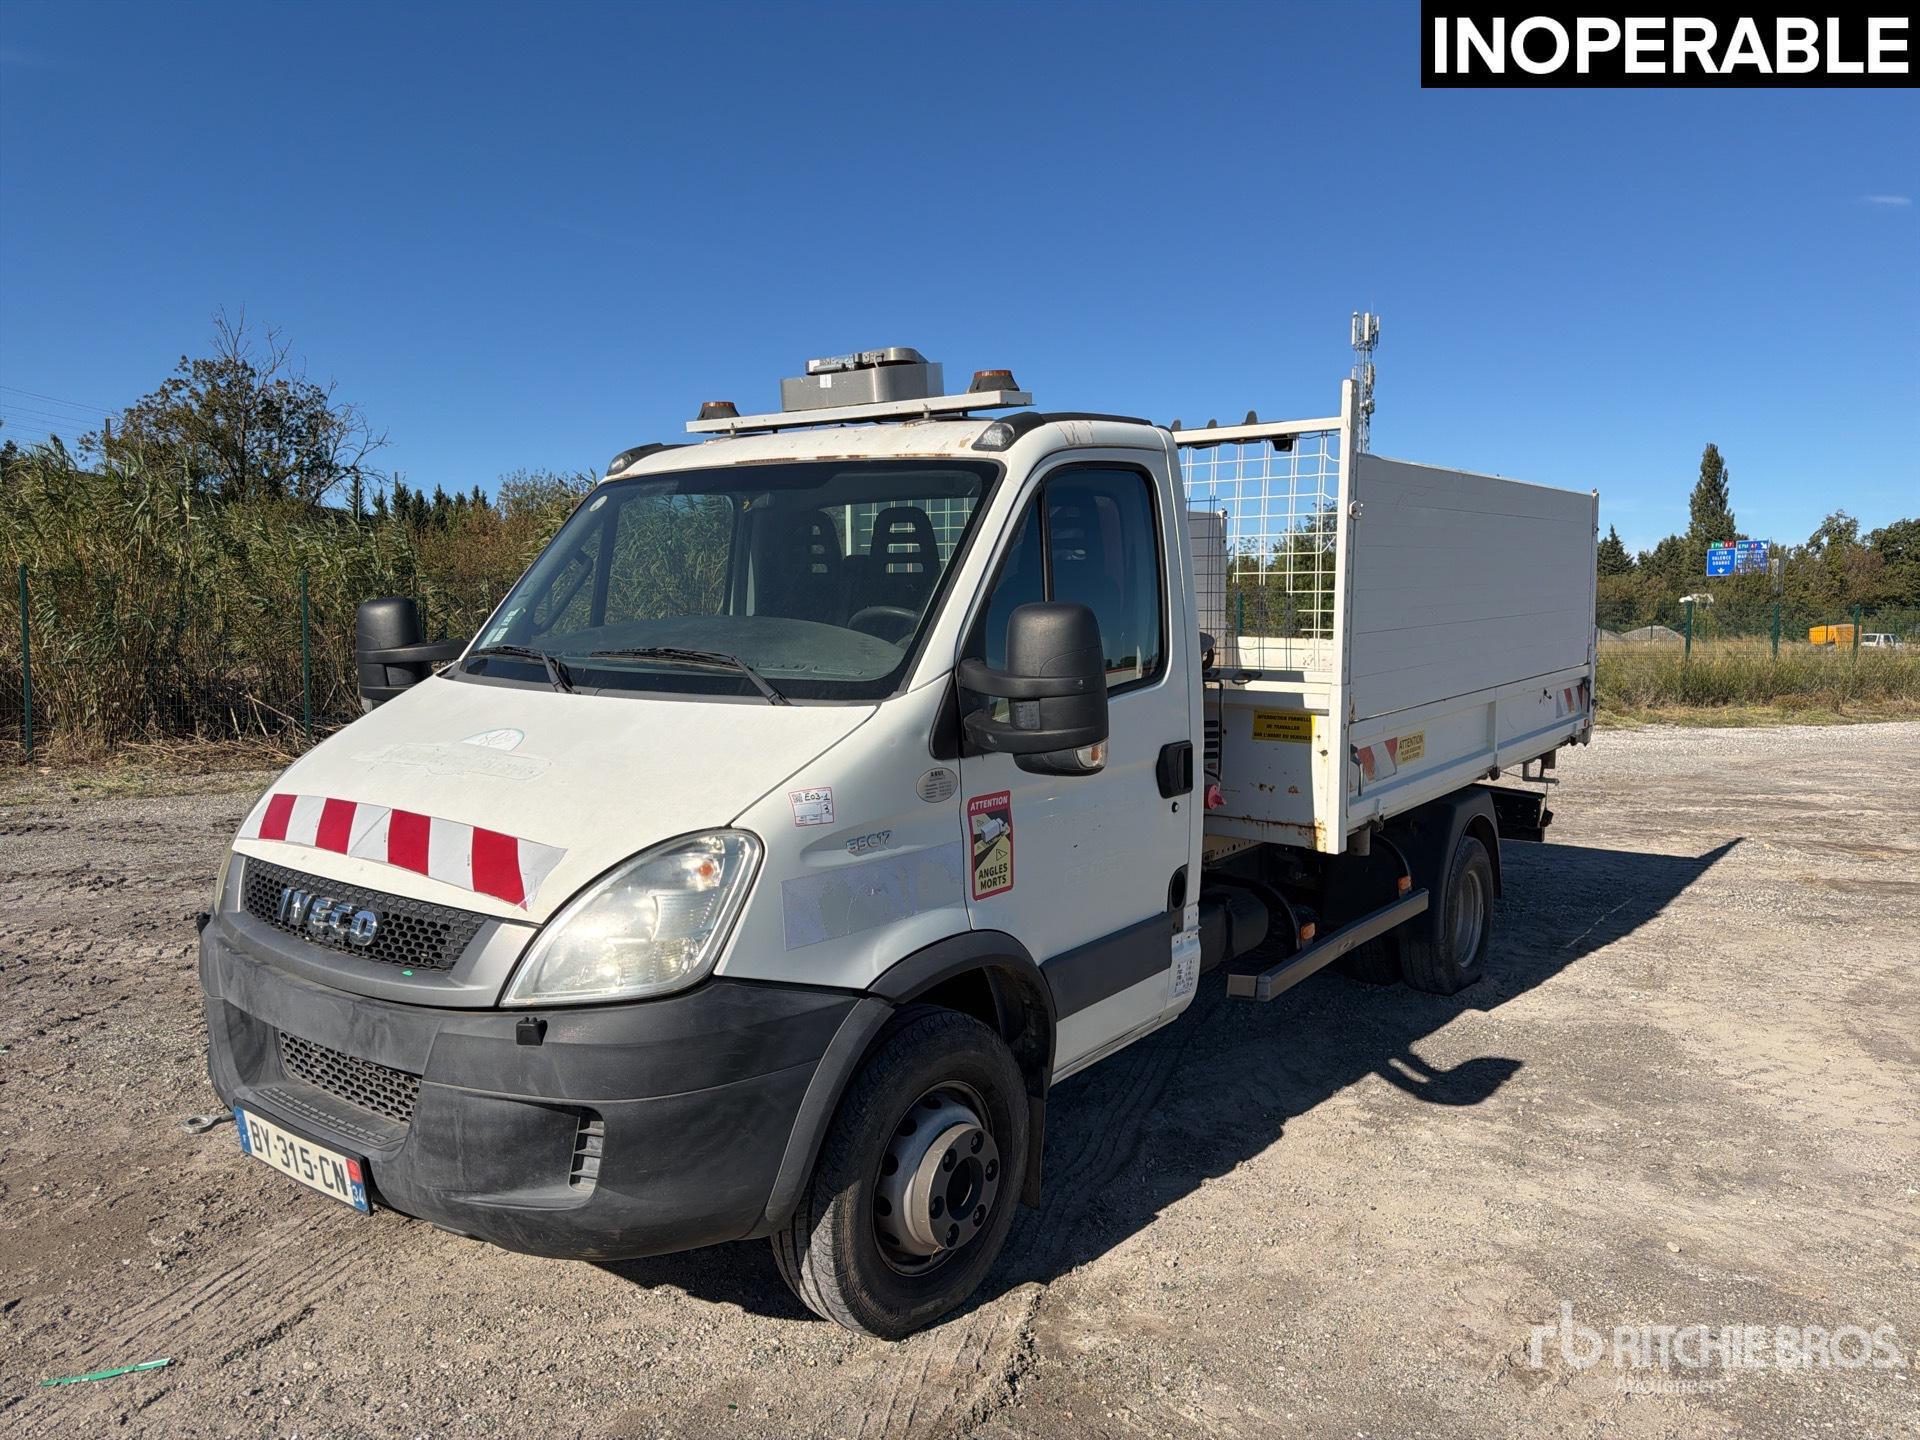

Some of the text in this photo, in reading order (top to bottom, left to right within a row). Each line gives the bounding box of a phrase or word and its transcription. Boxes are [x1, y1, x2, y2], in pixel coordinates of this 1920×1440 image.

[1399, 735, 1424, 750] ATTENTION
[970, 796, 1008, 812] ATTENTION
[978, 863, 1008, 880] ANGLES
[981, 874, 1007, 891] MORTS
[279, 886, 380, 946] IVECO
[249, 1119, 349, 1196] BY-315-CN
[352, 1184, 365, 1205] 34
